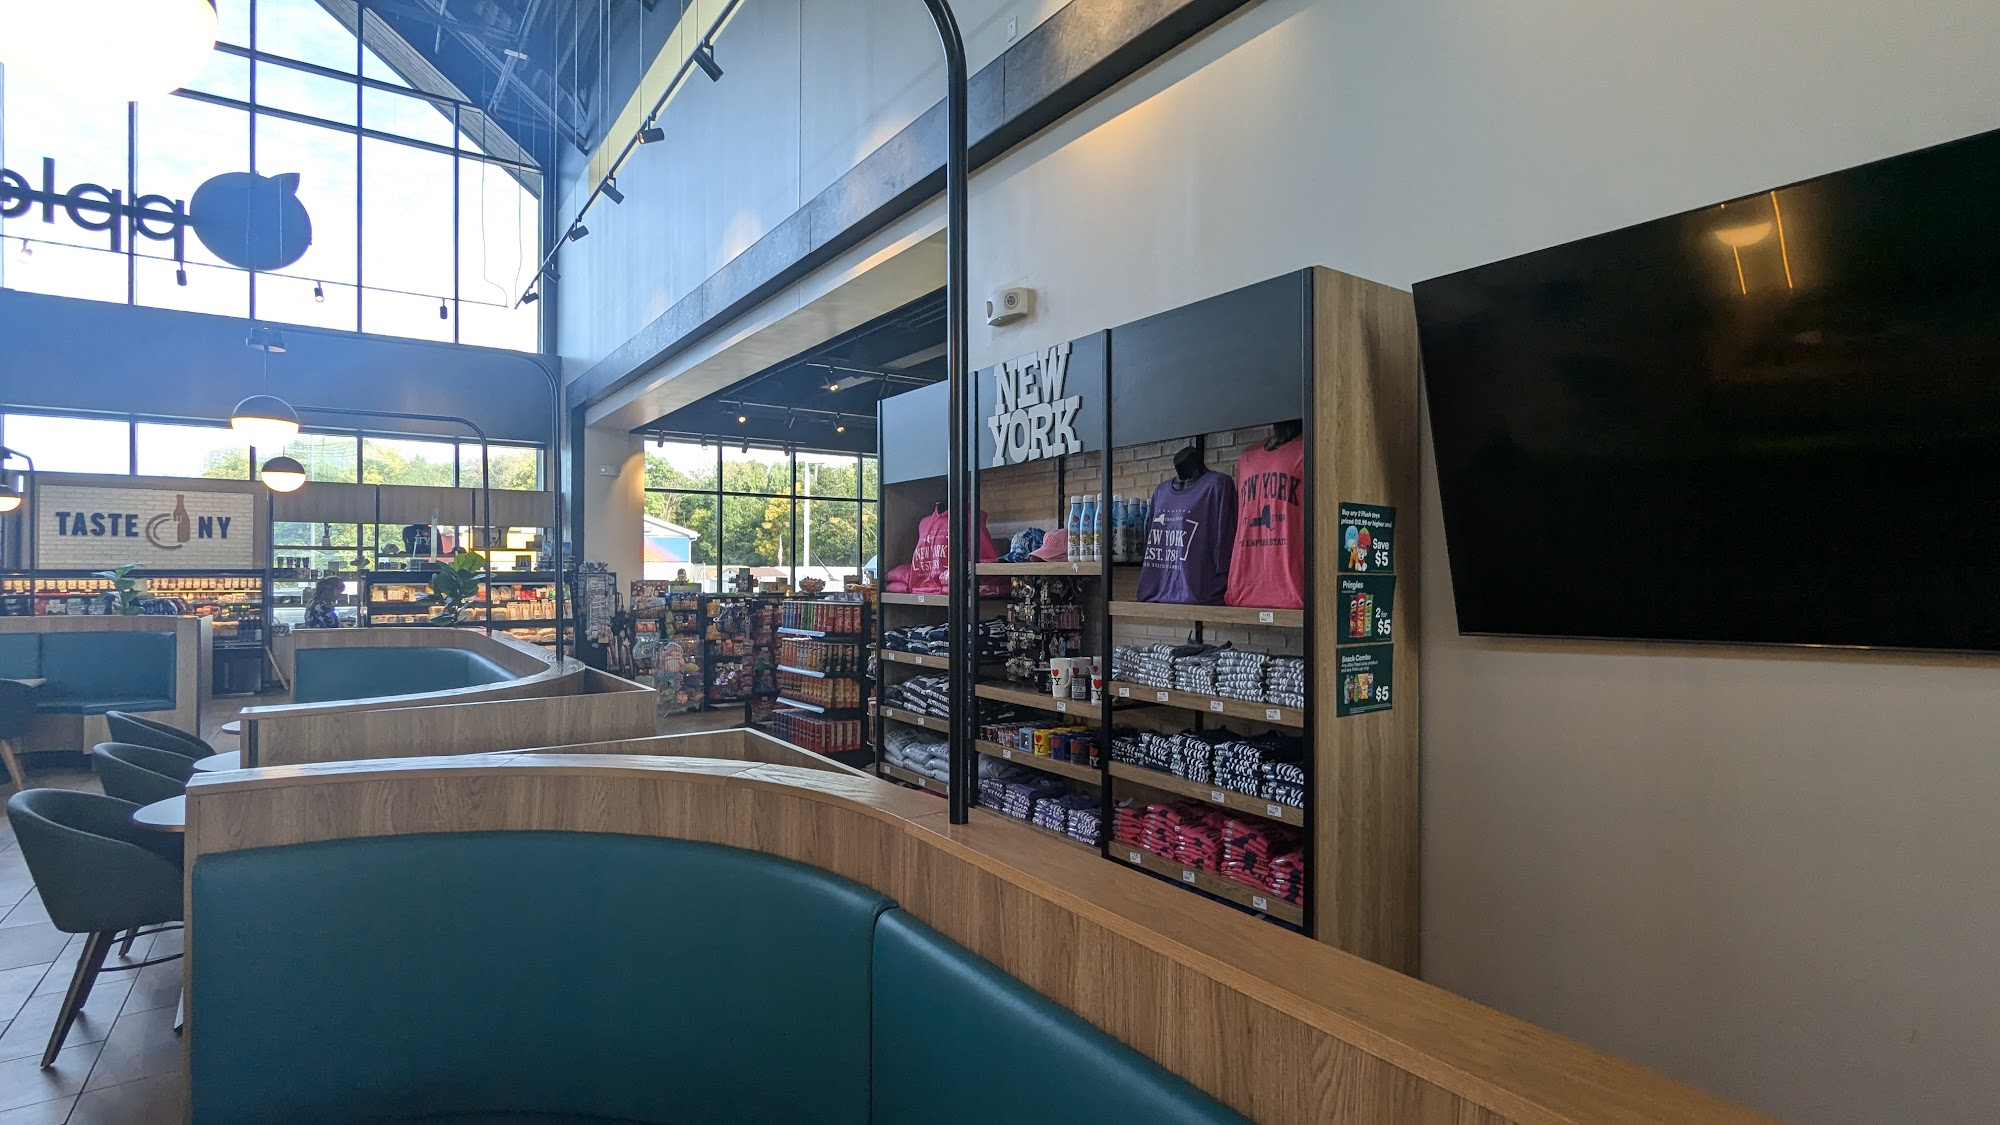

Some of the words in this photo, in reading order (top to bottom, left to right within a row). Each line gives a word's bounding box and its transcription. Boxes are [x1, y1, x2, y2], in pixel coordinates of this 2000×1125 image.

[994, 341, 1072, 415] NEW
[988, 395, 1082, 467] YORK
[1262, 471, 1300, 507] YORK
[1342, 508, 1350, 518] Buy
[55, 511, 139, 537] TASTE
[198, 516, 231, 539] NY
[1373, 538, 1389, 550] Save
[1375, 550, 1388, 567] $5
[1342, 580, 1364, 590] Pringles
[1375, 607, 1381, 618] 2
[1378, 618, 1390, 635] $5
[1376, 686, 1389, 702] $5
